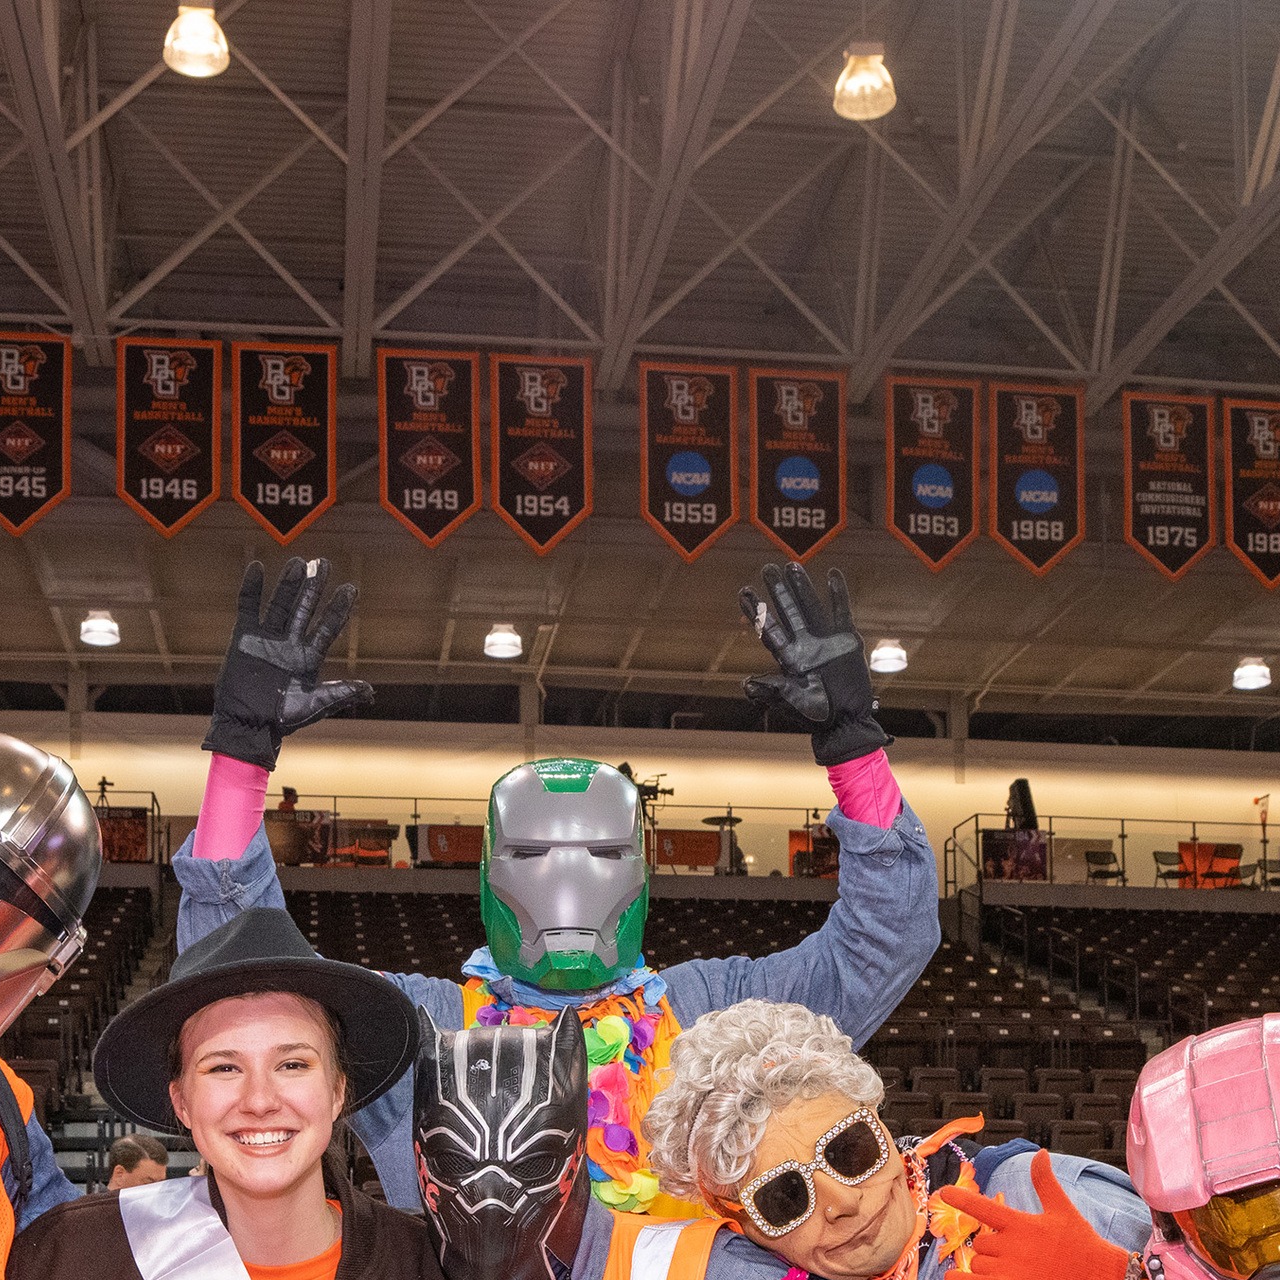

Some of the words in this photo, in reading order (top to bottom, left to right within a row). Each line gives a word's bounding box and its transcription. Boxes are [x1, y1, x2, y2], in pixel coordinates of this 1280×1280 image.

[5, 437, 33, 447] NIT
[155, 444, 186, 454] NIT
[270, 449, 301, 460] NIT
[415, 455, 446, 466] NIT
[528, 461, 558, 472] NIT
[670, 471, 711, 486] NCAA
[780, 477, 820, 491] NCAA
[140, 478, 198, 500] 1946
[256, 482, 314, 506] 1948
[916, 484, 954, 499] NCAA
[1148, 480, 1193, 493] NATIONAL
[403, 488, 459, 510] 1949
[1019, 491, 1059, 504] NCAA
[515, 494, 571, 517] 1954
[1139, 503, 1203, 518] INVITATIONAL
[664, 502, 717, 525] 1959
[772, 506, 826, 529] 1962
[908, 513, 960, 538] 1963
[1011, 520, 1065, 542] 1968
[1147, 525, 1198, 548] 1975
